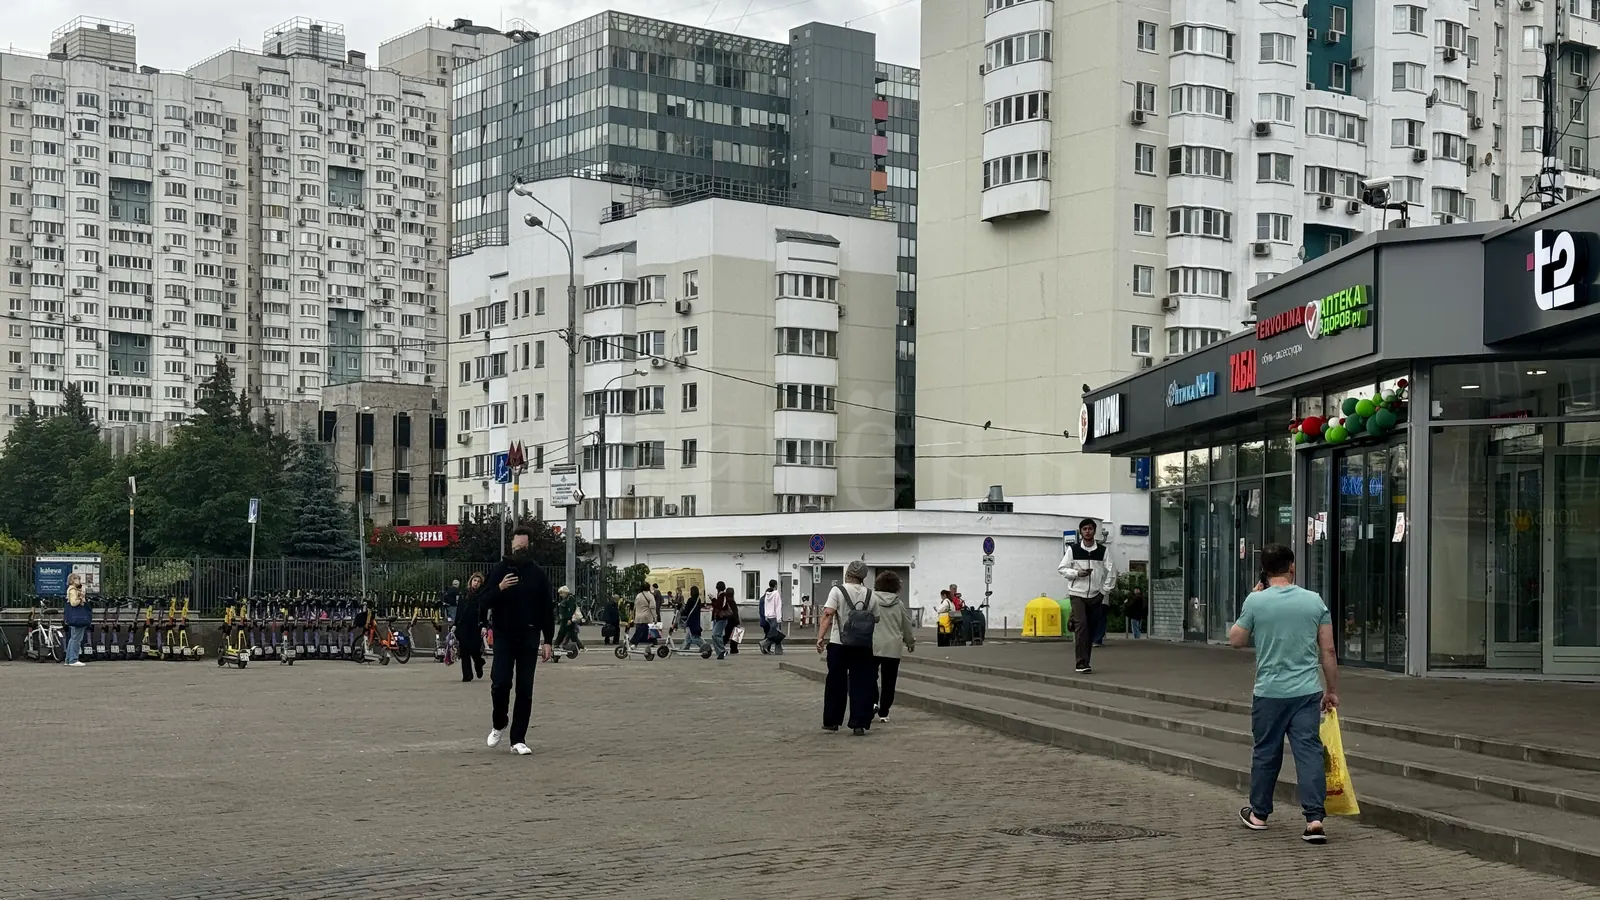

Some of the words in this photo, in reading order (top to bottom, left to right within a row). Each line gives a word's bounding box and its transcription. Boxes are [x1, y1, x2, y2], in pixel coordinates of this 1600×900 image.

[1527, 229, 1575, 311] t2
[1319, 285, 1362, 318] АПТЕКА
[1256, 307, 1304, 340] TERVOLINA
